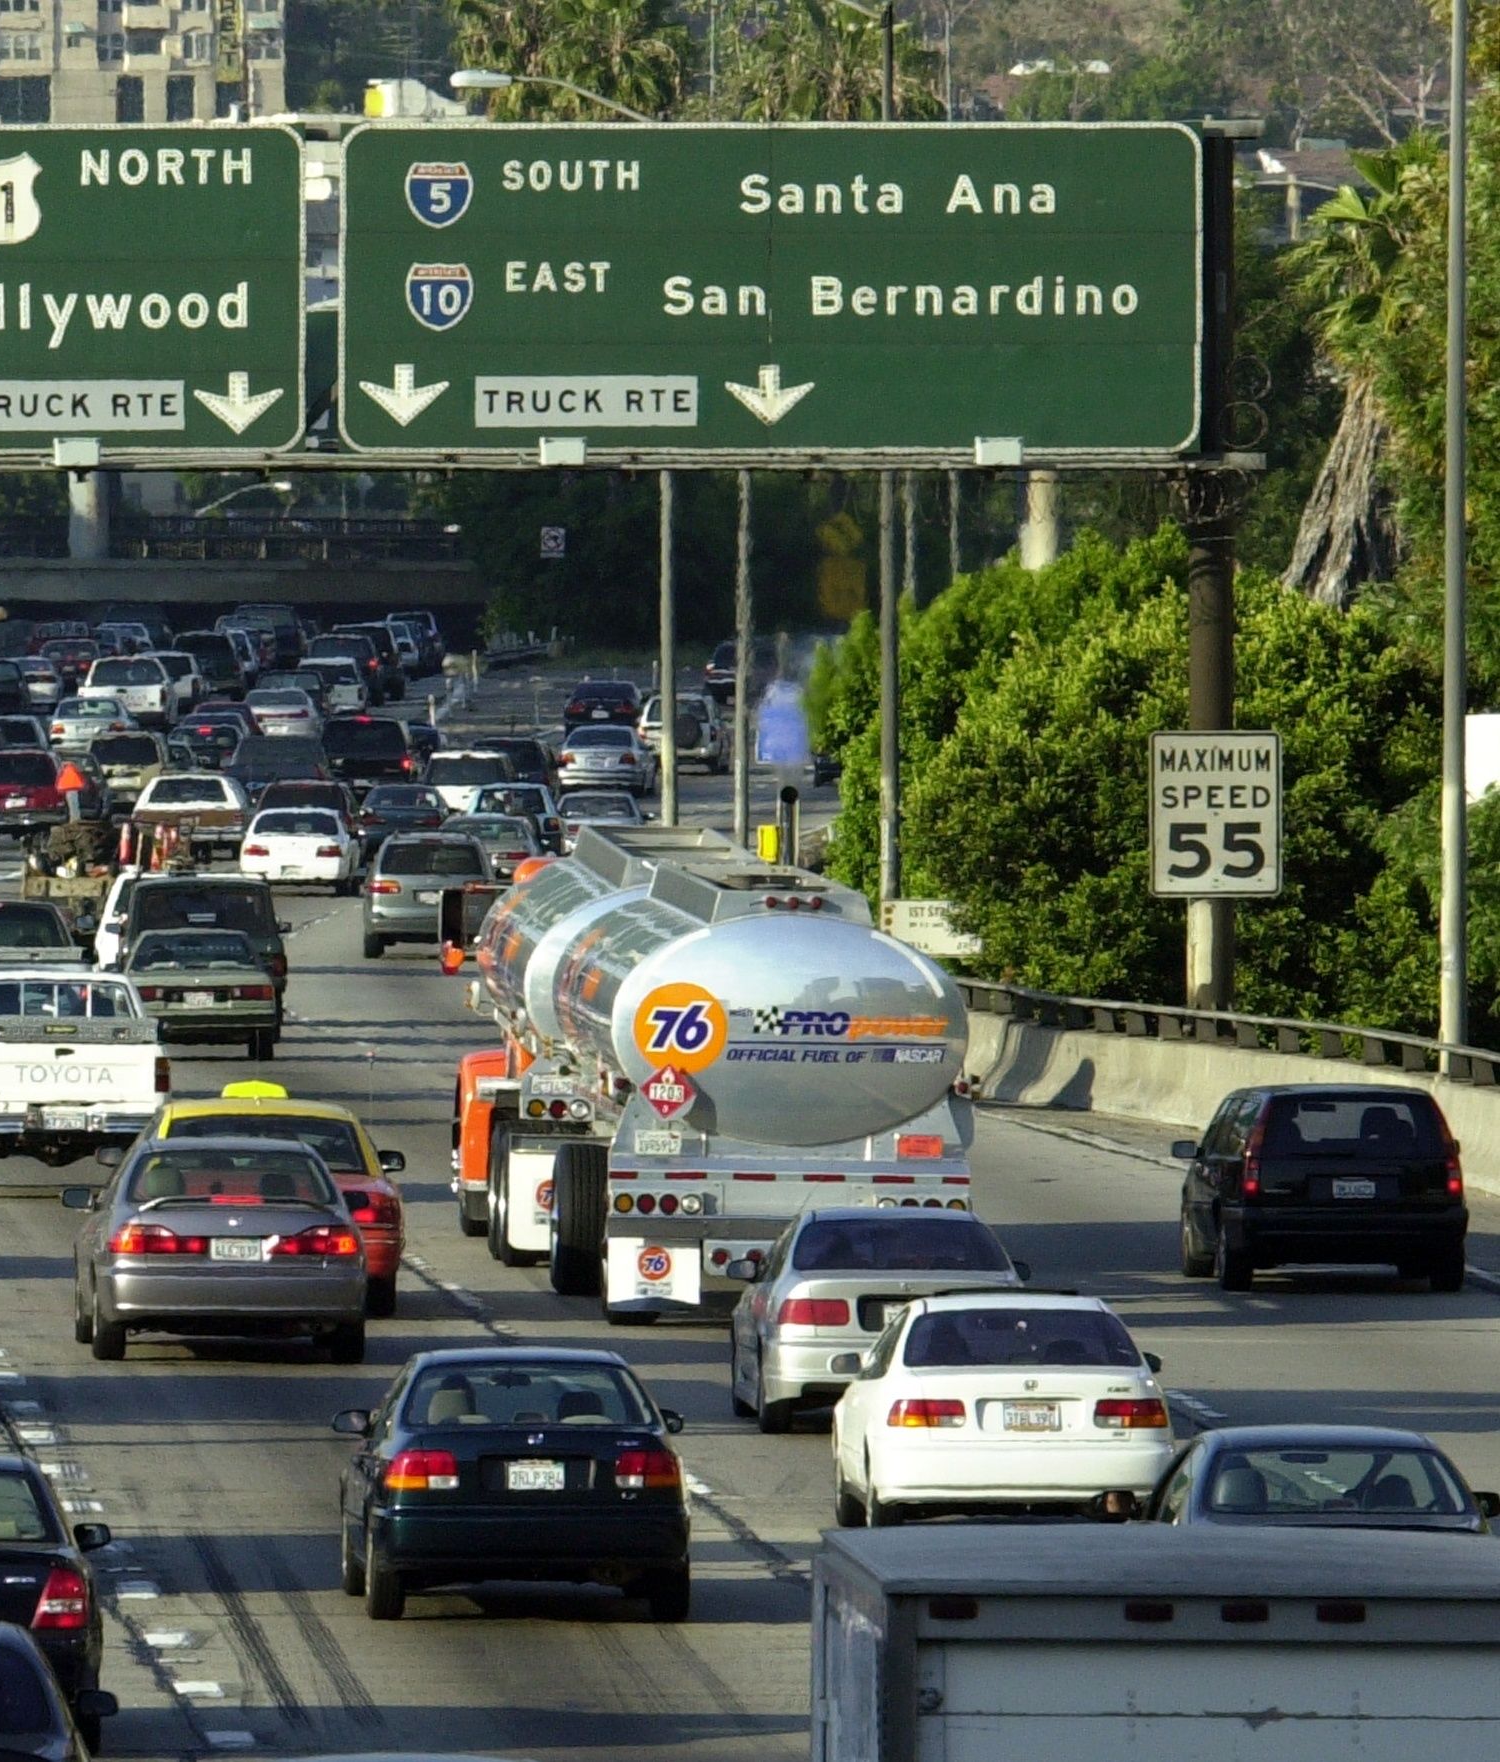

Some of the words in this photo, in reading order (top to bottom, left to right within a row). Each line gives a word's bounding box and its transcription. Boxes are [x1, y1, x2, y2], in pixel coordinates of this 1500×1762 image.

[80, 147, 252, 186] NORTH
[502, 159, 640, 191] SOUTH
[429, 182, 452, 214] 5
[740, 174, 903, 214] Santa
[946, 174, 1057, 214] Ana
[505, 261, 611, 293] EAST
[419, 284, 462, 316] 10
[663, 275, 767, 316] San
[811, 275, 1140, 316] Bernardino
[111, 393, 179, 418] RTE
[482, 389, 602, 415] TRUCK
[624, 389, 692, 415] RTE
[1160, 748, 1271, 772] MAXIMUM
[1161, 784, 1271, 809] SPEED
[1167, 821, 1267, 879] 55
[647, 1002, 713, 1052] 76
[726, 1048, 796, 1063] OFFICIAL
[801, 1049, 840, 1063] FUEL
[845, 1050, 869, 1064] OF
[894, 1048, 944, 1064] NASCAR
[14, 1064, 114, 1085] TOYOTA
[651, 1084, 684, 1100] 1203
[643, 1255, 667, 1273] 76
